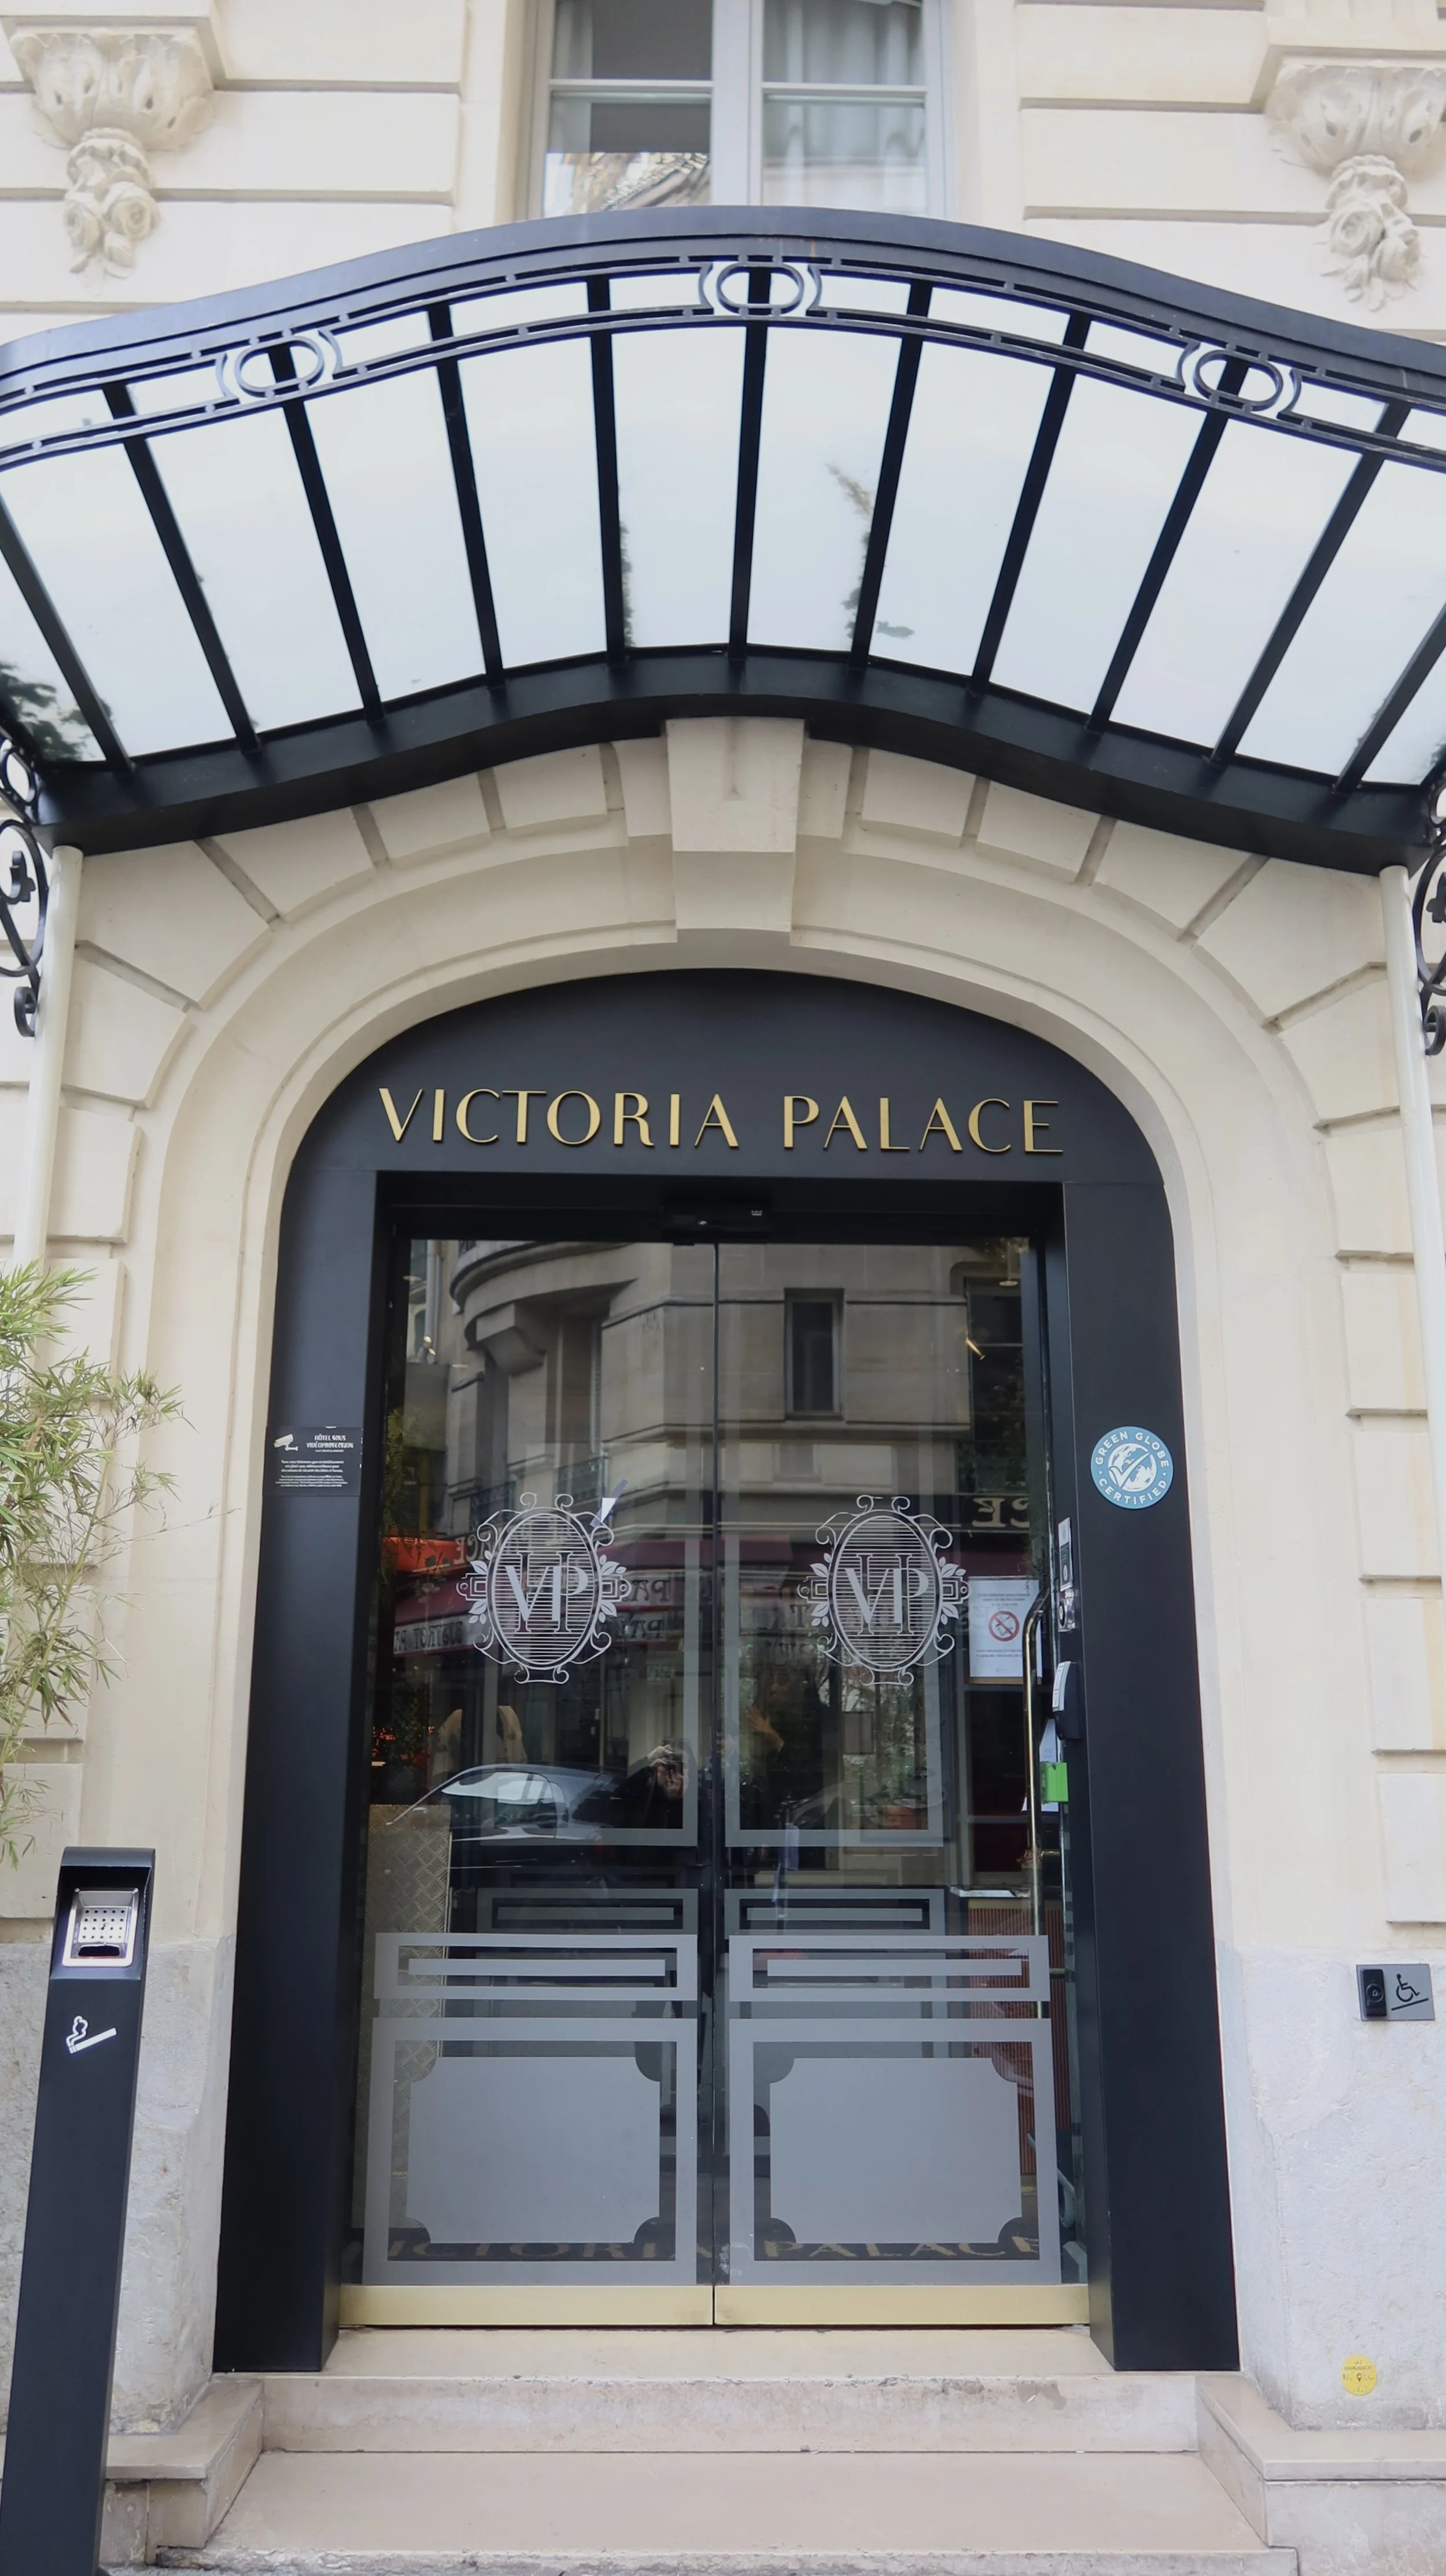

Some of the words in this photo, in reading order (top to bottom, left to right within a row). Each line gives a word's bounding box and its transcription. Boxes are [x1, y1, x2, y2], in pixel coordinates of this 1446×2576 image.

[378, 1088, 739, 1149] VICTORIA
[783, 1095, 1064, 1154] PALACE
[1095, 1431, 1128, 1465] GREEN
[1135, 1432, 1169, 1467] GLOBE
[1099, 1478, 1167, 1505] CERTIFIED
